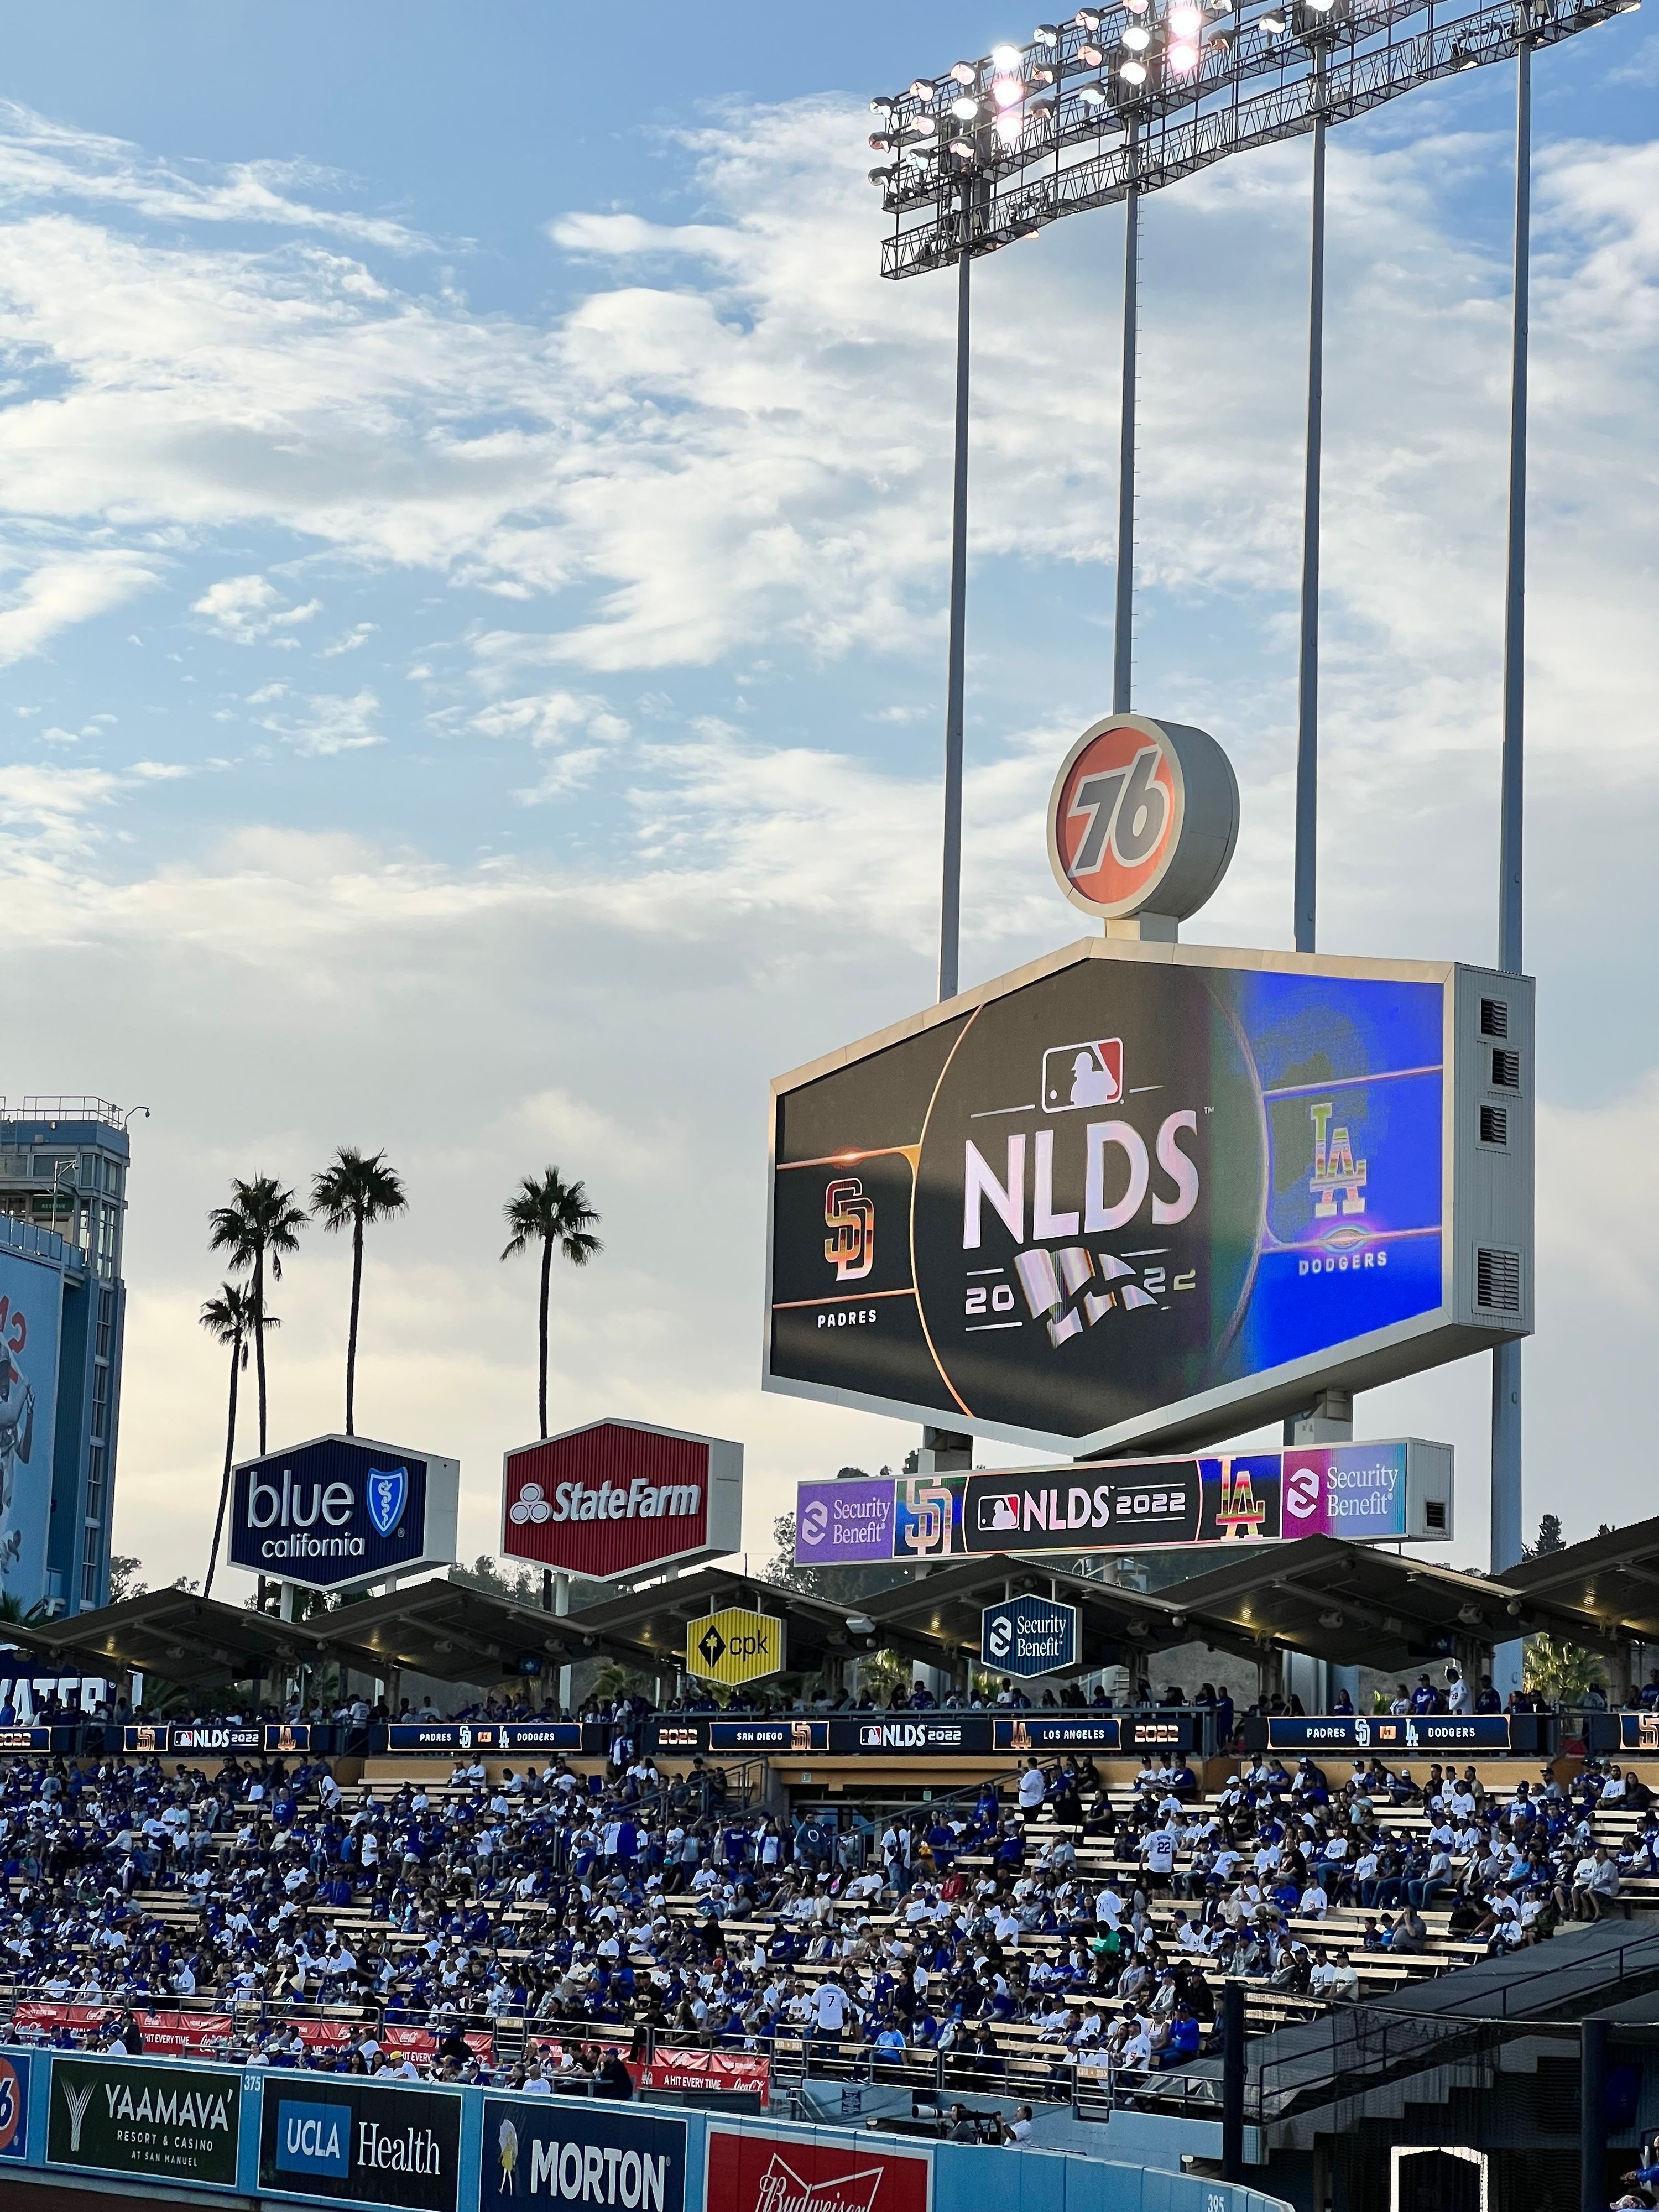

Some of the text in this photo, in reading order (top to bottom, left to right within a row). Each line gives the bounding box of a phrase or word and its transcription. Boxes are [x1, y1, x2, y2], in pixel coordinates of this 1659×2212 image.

[1067, 744, 1162, 878] 76
[963, 1110, 1199, 1249] NLDS
[1299, 1251, 1386, 1275] DODGERS
[966, 1285, 1014, 1314] 20
[817, 1309, 877, 1328] PADRES
[1327, 1463, 1399, 1491] Security
[247, 1469, 354, 1528] blue
[833, 1496, 891, 1522] Security
[1023, 1485, 1186, 1531] NLDS 2022
[1326, 1491, 1389, 1517] Benefit
[832, 1521, 883, 1545] Benefit
[262, 1532, 365, 1558] california
[1017, 1614, 1067, 1638] Security
[729, 1629, 769, 1662] cpk
[1017, 1637, 1059, 1657] Benefit
[194, 1729, 259, 1747] NLDS 2022
[420, 1733, 452, 1741] PADRES
[517, 1732, 555, 1741] DODGERS
[658, 1729, 698, 1744] 2022
[737, 1731, 754, 1741] SAN
[757, 1731, 783, 1741] DIEGO
[883, 1724, 961, 1747] NLDS 2022
[1042, 1729, 1061, 1740] LOS
[1063, 1729, 1105, 1740] ANGELES
[1134, 1725, 1179, 1743] 2022
[1306, 1728, 1346, 1738] PADRES
[1428, 1726, 1476, 1738] DODGERS
[1157, 1841, 1171, 1854] 22
[828, 1995, 834, 2008] 7
[155, 2034, 175, 2044] EVERY
[175, 2036, 190, 2045] TIME
[411, 2052, 432, 2063] EVERY
[244, 2075, 262, 2092] 375
[664, 2075, 669, 2085] A
[670, 2076, 681, 2086] HIT
[682, 2077, 704, 2089] EVERY
[705, 2078, 722, 2090] TIME
[0, 2077, 14, 2131] 6
[117, 2130, 213, 2152] RESORT & CASINO
[286, 2117, 441, 2175] UCLA Health
[131, 2150, 198, 2167] AT SAN MANUEL
[530, 2139, 665, 2212] MORTON
[1208, 2194, 1224, 2212] 395
